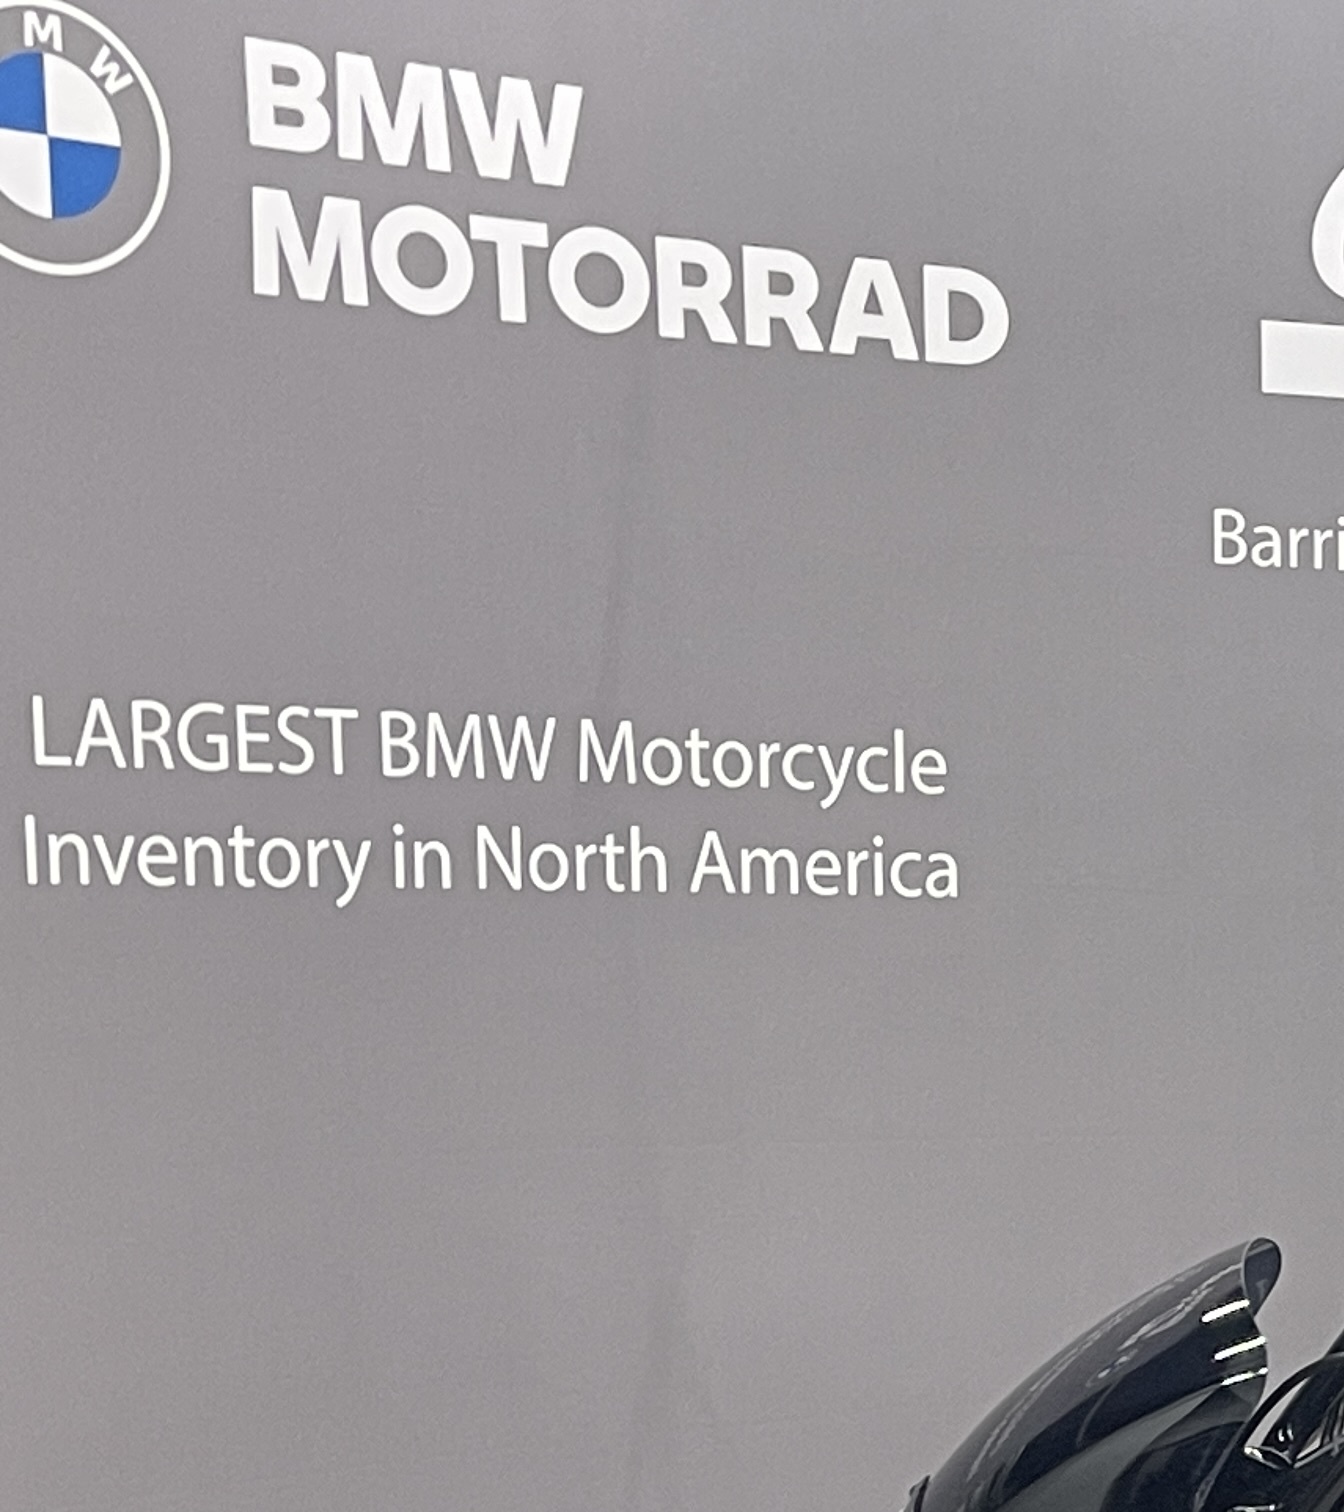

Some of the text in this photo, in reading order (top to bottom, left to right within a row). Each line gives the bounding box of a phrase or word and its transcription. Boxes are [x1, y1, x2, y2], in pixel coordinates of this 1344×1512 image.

[23, 10, 134, 96] MW
[243, 36, 584, 188] BMW
[252, 185, 1011, 366] MOTORRAD
[31, 695, 948, 810] LARGEST BMW Motorcycle
[23, 814, 959, 908] Inventory in North America
